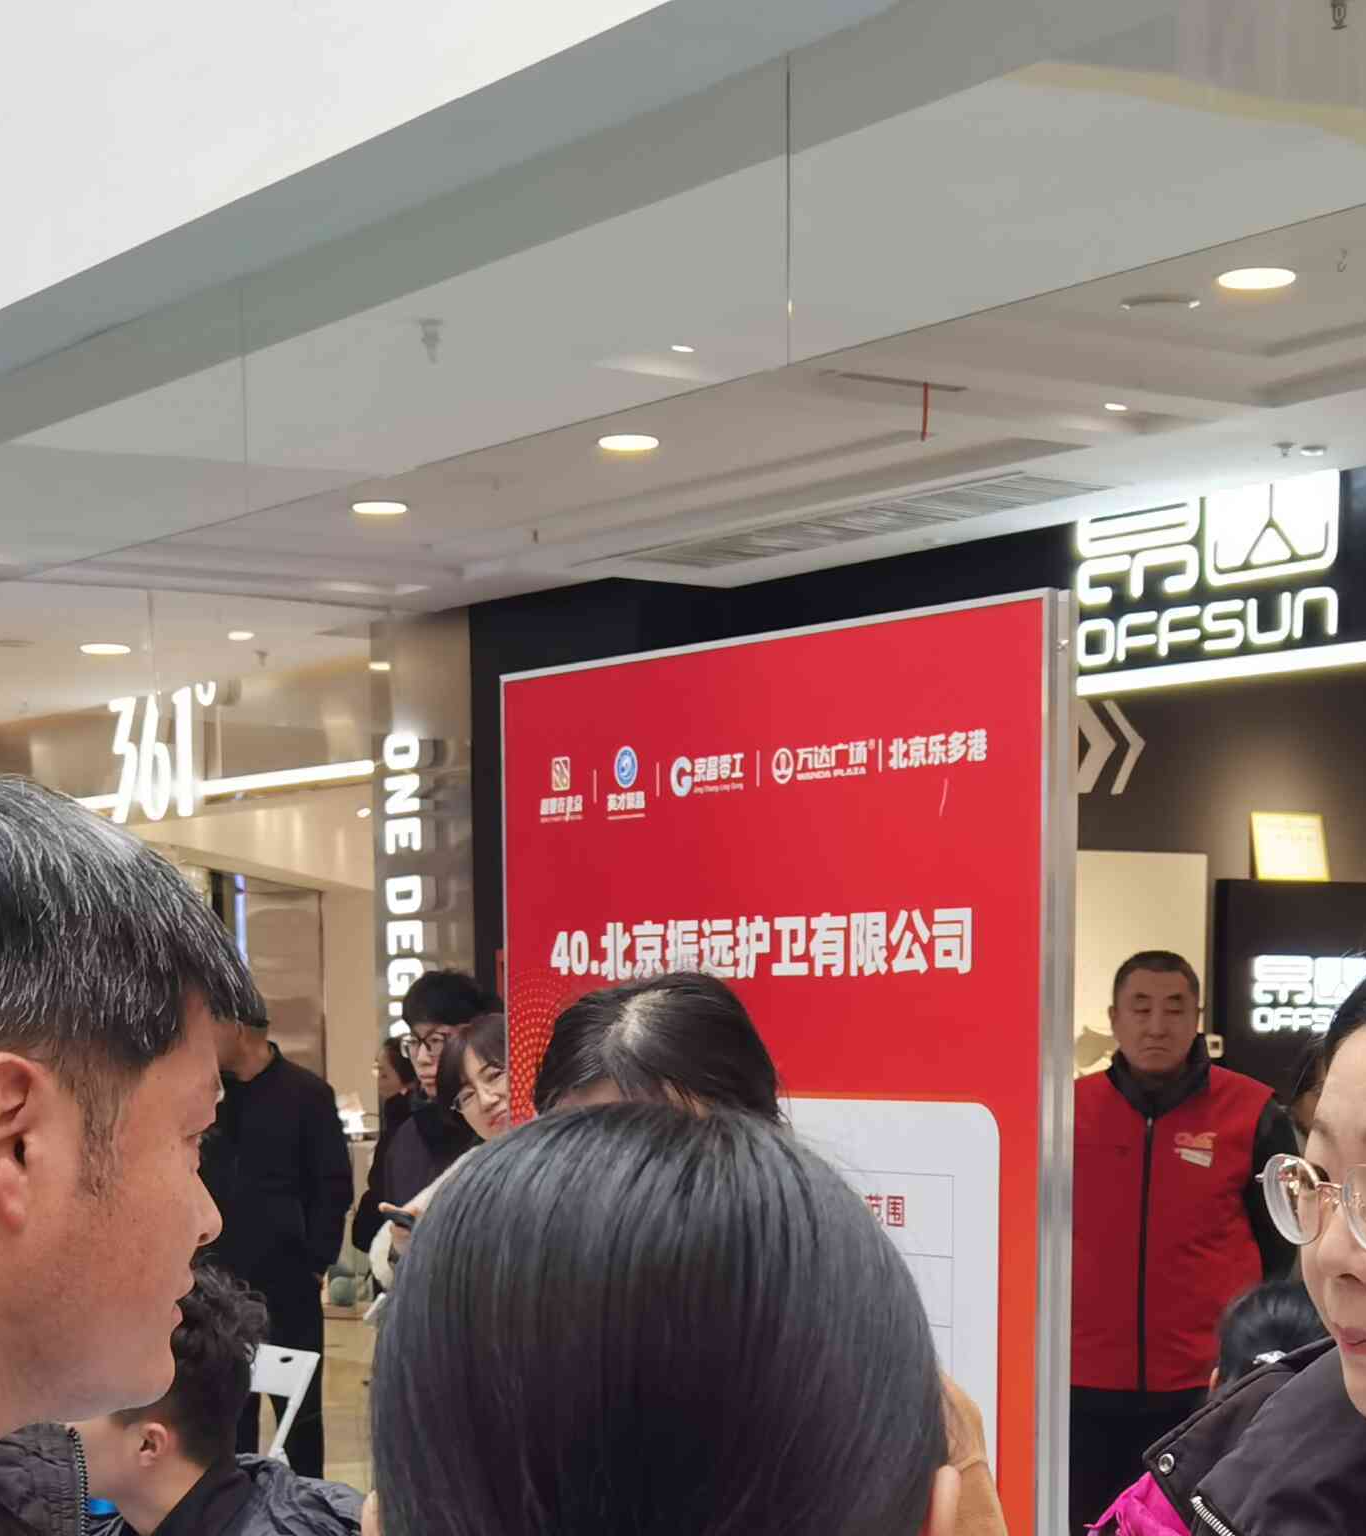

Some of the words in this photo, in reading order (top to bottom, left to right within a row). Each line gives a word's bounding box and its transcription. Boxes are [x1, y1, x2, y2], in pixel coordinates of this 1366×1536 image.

[1076, 586, 1339, 668] OFFSUN
[888, 728, 987, 770] 北京乐多港
[382, 733, 422, 855] ONE
[550, 907, 973, 981] 40.北京振远护卫有限公司
[1251, 1006, 1337, 1033] OFFS
